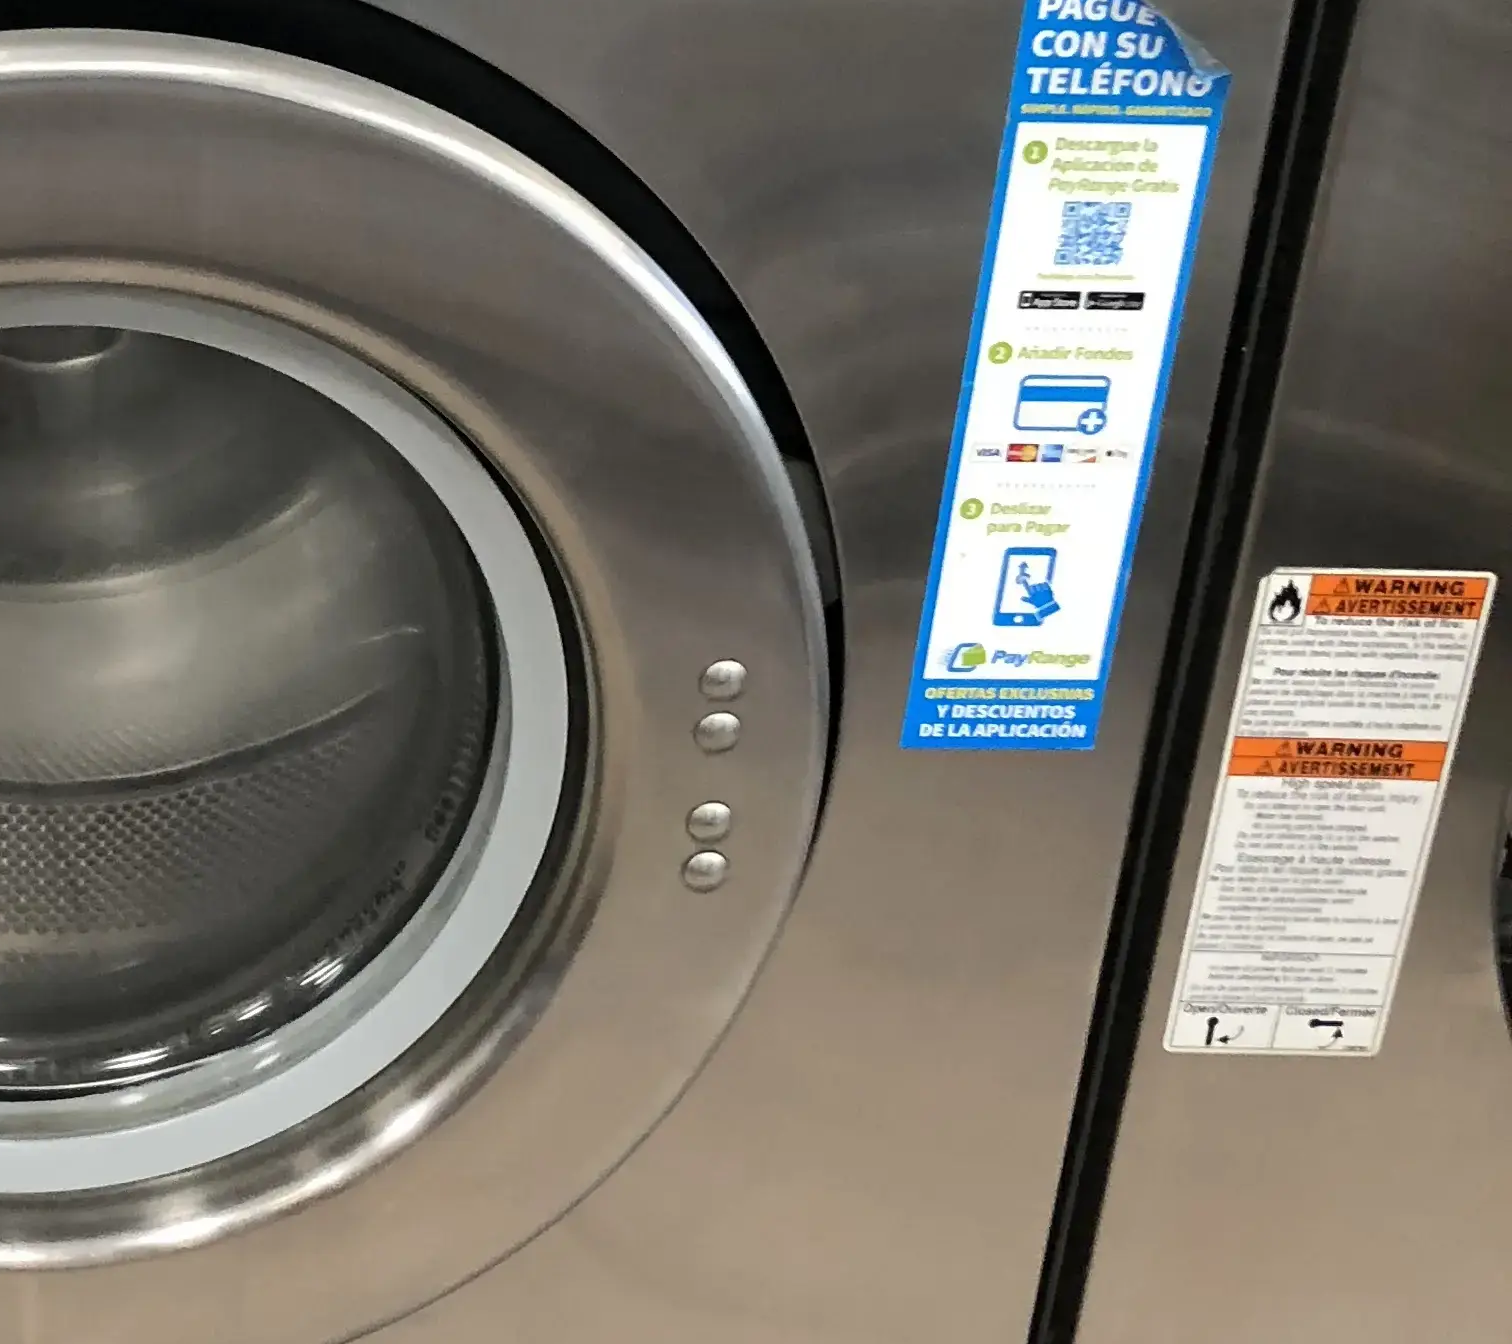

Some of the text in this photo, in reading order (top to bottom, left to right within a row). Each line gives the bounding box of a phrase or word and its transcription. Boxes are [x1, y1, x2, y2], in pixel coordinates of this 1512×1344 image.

[1032, 30, 1166, 59] CON SU
[1026, 61, 1213, 97] TELÉFONO
[1355, 578, 1465, 596] WARNING
[1336, 598, 1477, 616] AVERTISSEMENT
[990, 650, 1090, 668] PayRange
[924, 687, 1095, 701] OFERTAS EXCLUSIVAS
[936, 705, 1076, 719] Y DESCUENTOS
[919, 721, 1088, 739] DE LA APLICACIÓN
[1296, 741, 1403, 758] WARNING
[1277, 760, 1415, 777] AVERTISSEMENT
